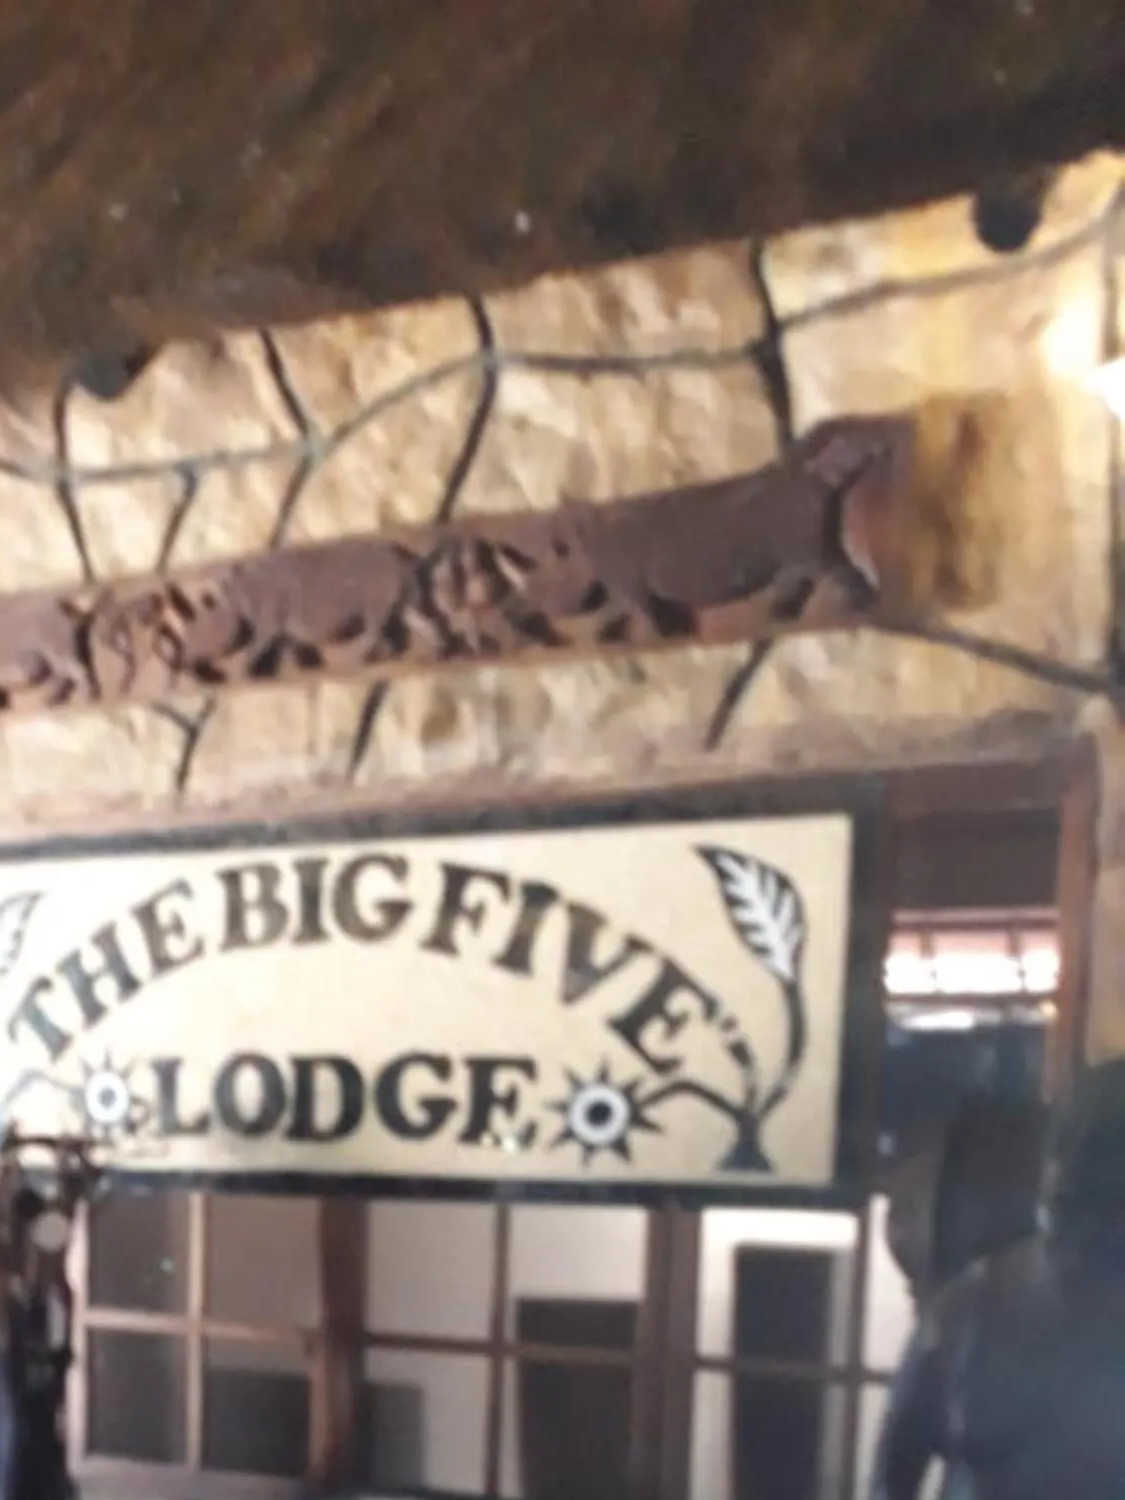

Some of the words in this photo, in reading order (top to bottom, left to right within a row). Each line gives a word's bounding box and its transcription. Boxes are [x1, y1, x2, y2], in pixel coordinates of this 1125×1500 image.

[8, 879, 206, 1064] THE
[216, 853, 413, 953] BIG
[421, 863, 725, 1074] FIVE
[151, 1052, 540, 1150] LODGE
